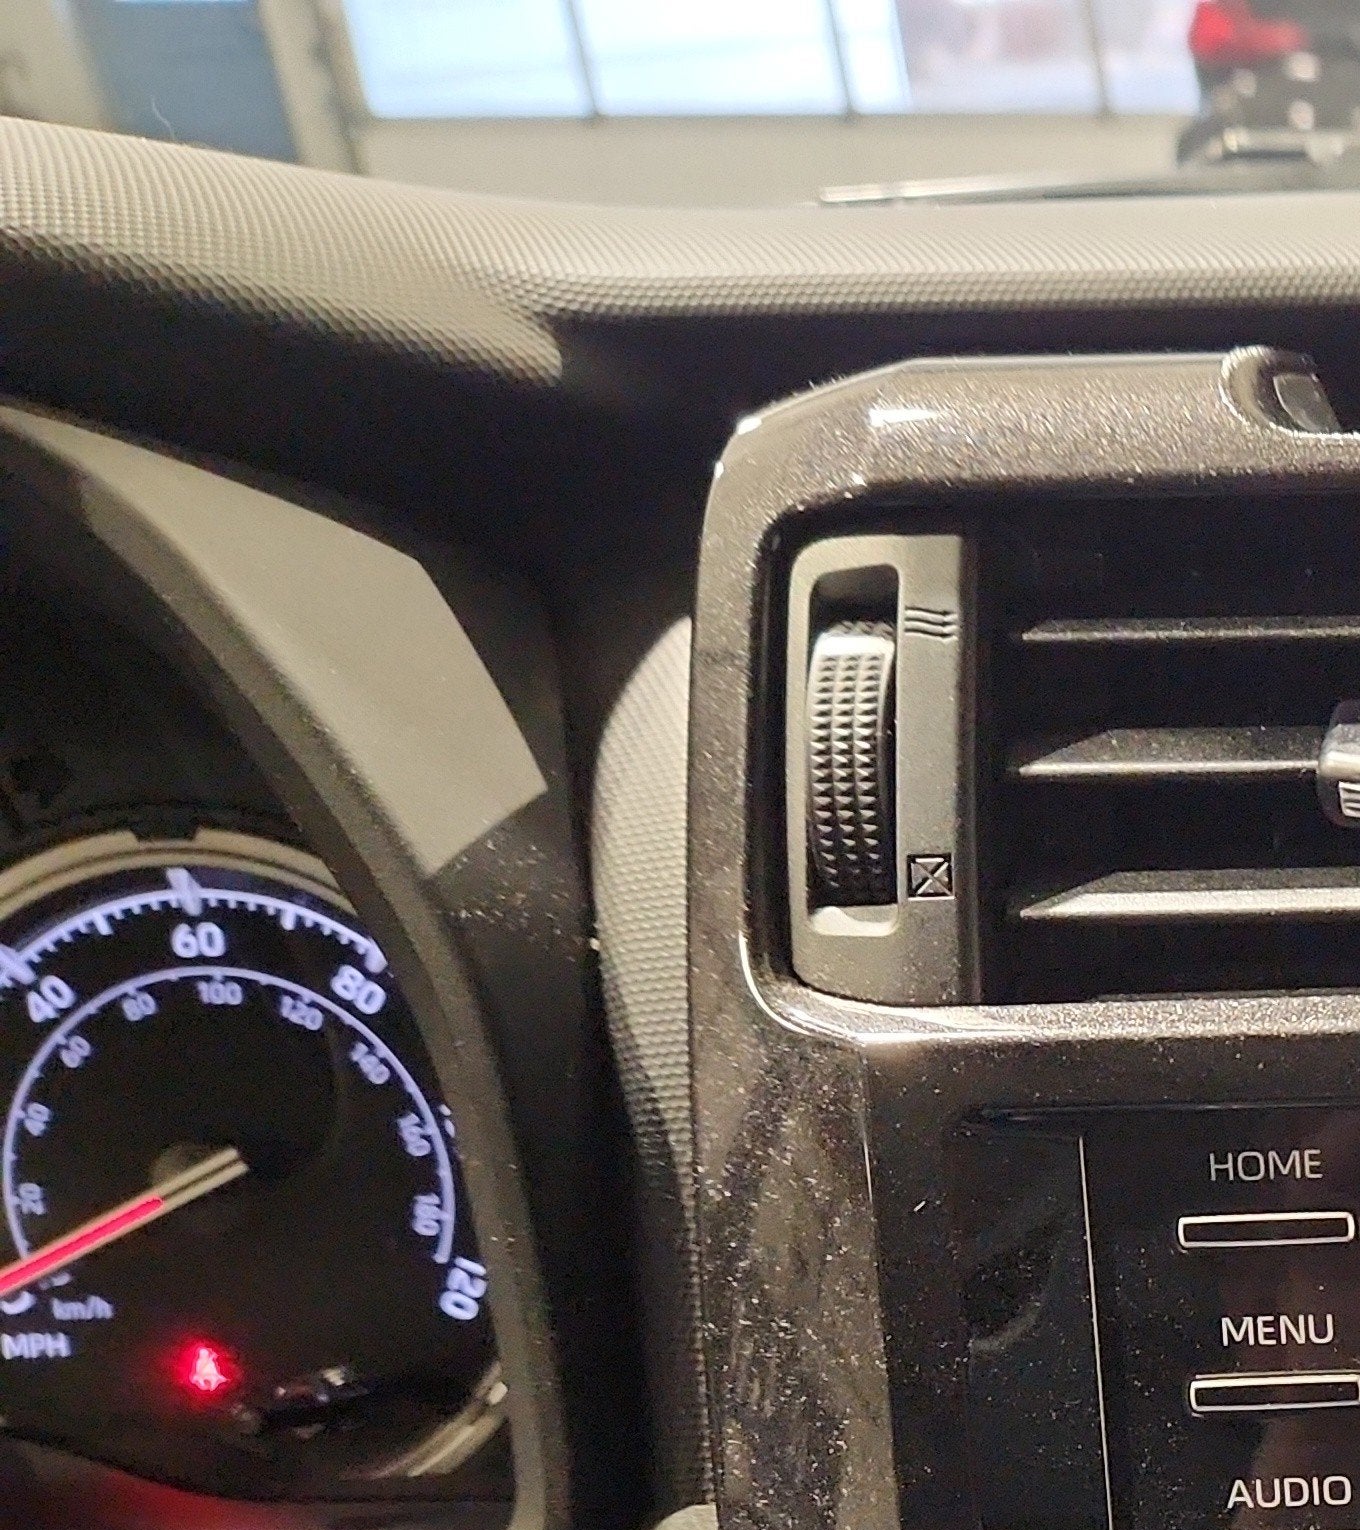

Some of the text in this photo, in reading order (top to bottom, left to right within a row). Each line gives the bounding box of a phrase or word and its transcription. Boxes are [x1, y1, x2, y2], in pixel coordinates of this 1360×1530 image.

[171, 921, 226, 959] 60
[26, 974, 76, 1024] 40
[198, 980, 243, 1007] 100
[330, 965, 387, 1015] 80
[279, 995, 324, 1032] 120
[1209, 1149, 1323, 1182] HOME
[439, 1257, 487, 1320] 120
[52, 1295, 114, 1321] km/h
[0, 1332, 71, 1360] MPH
[1221, 1314, 1335, 1348] MENU
[1227, 1475, 1352, 1509] AUDIO
